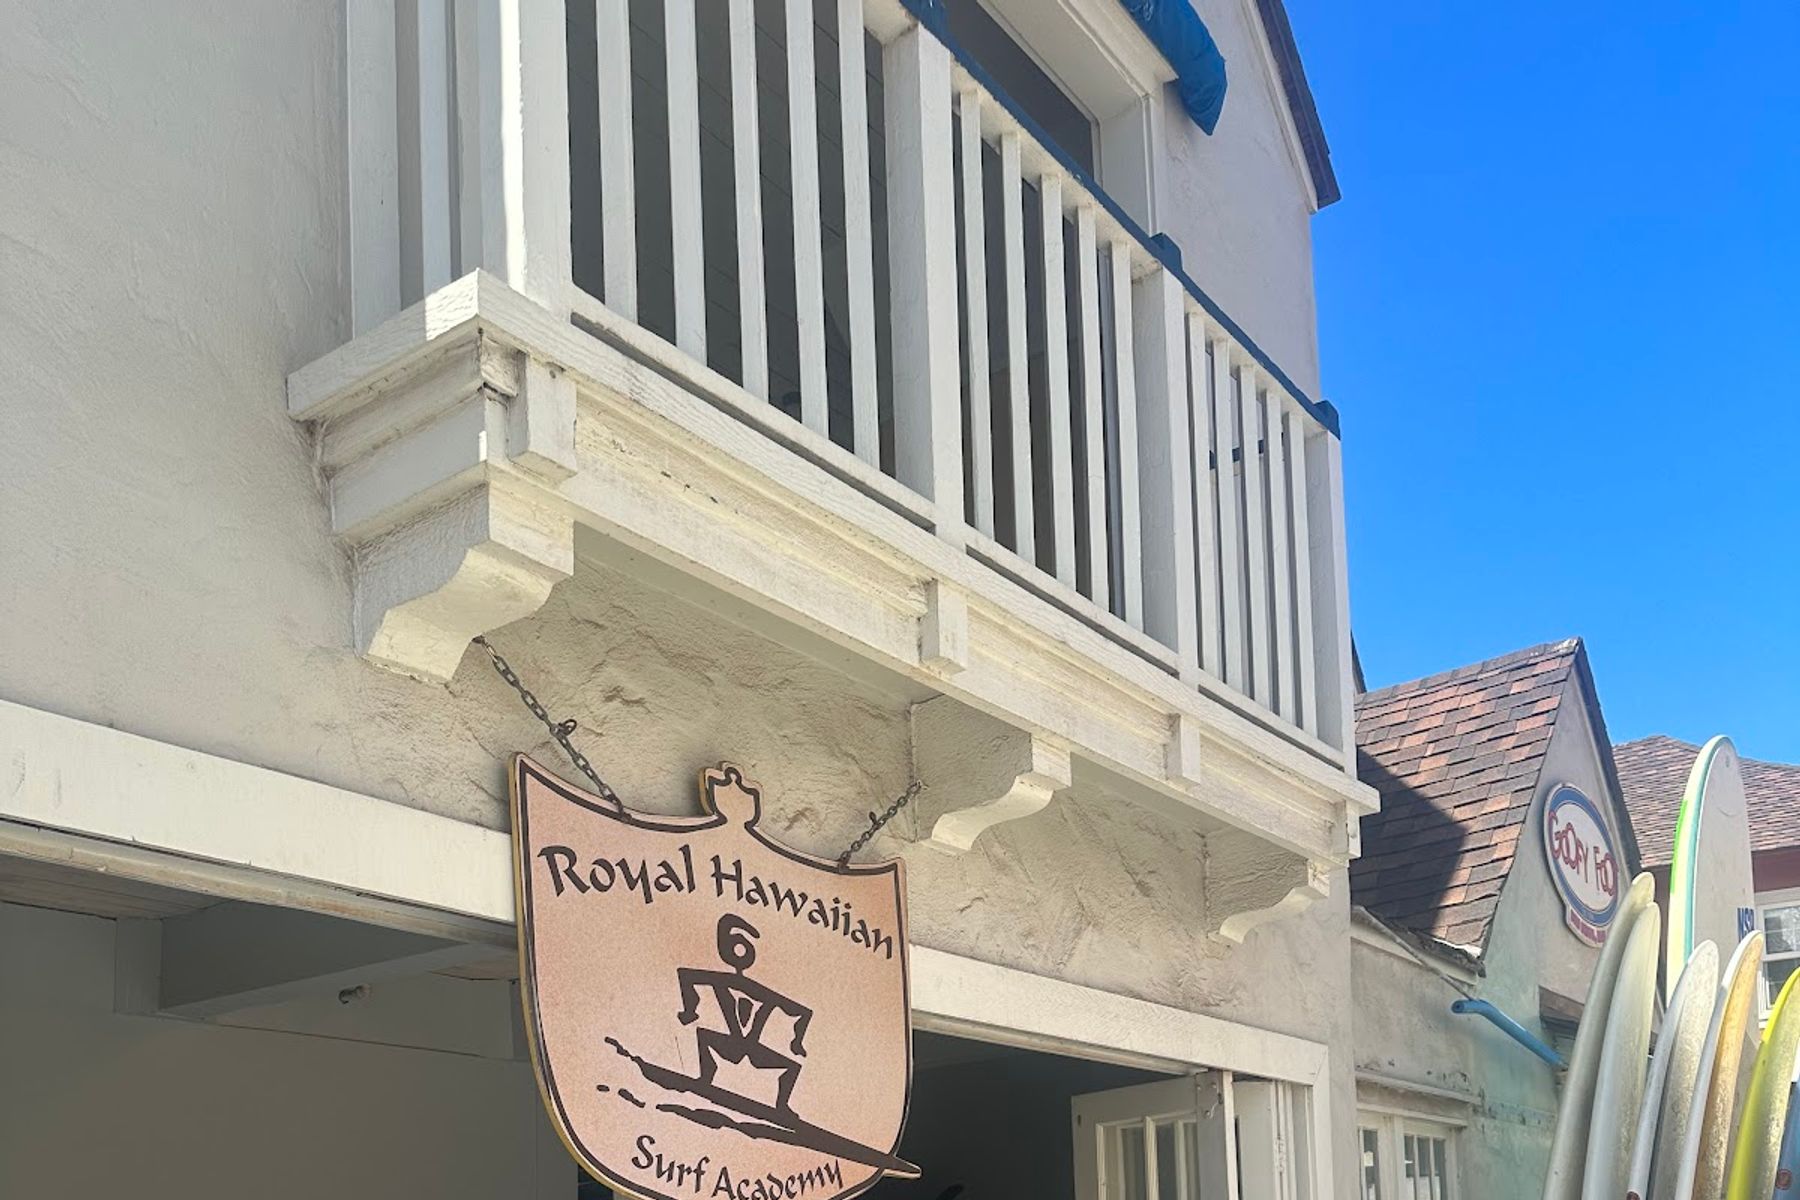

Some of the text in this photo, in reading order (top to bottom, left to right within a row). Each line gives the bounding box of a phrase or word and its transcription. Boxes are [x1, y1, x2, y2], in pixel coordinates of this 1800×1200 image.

[538, 844, 893, 960] Royal Hawaiian
[632, 1135, 709, 1193] Surf
